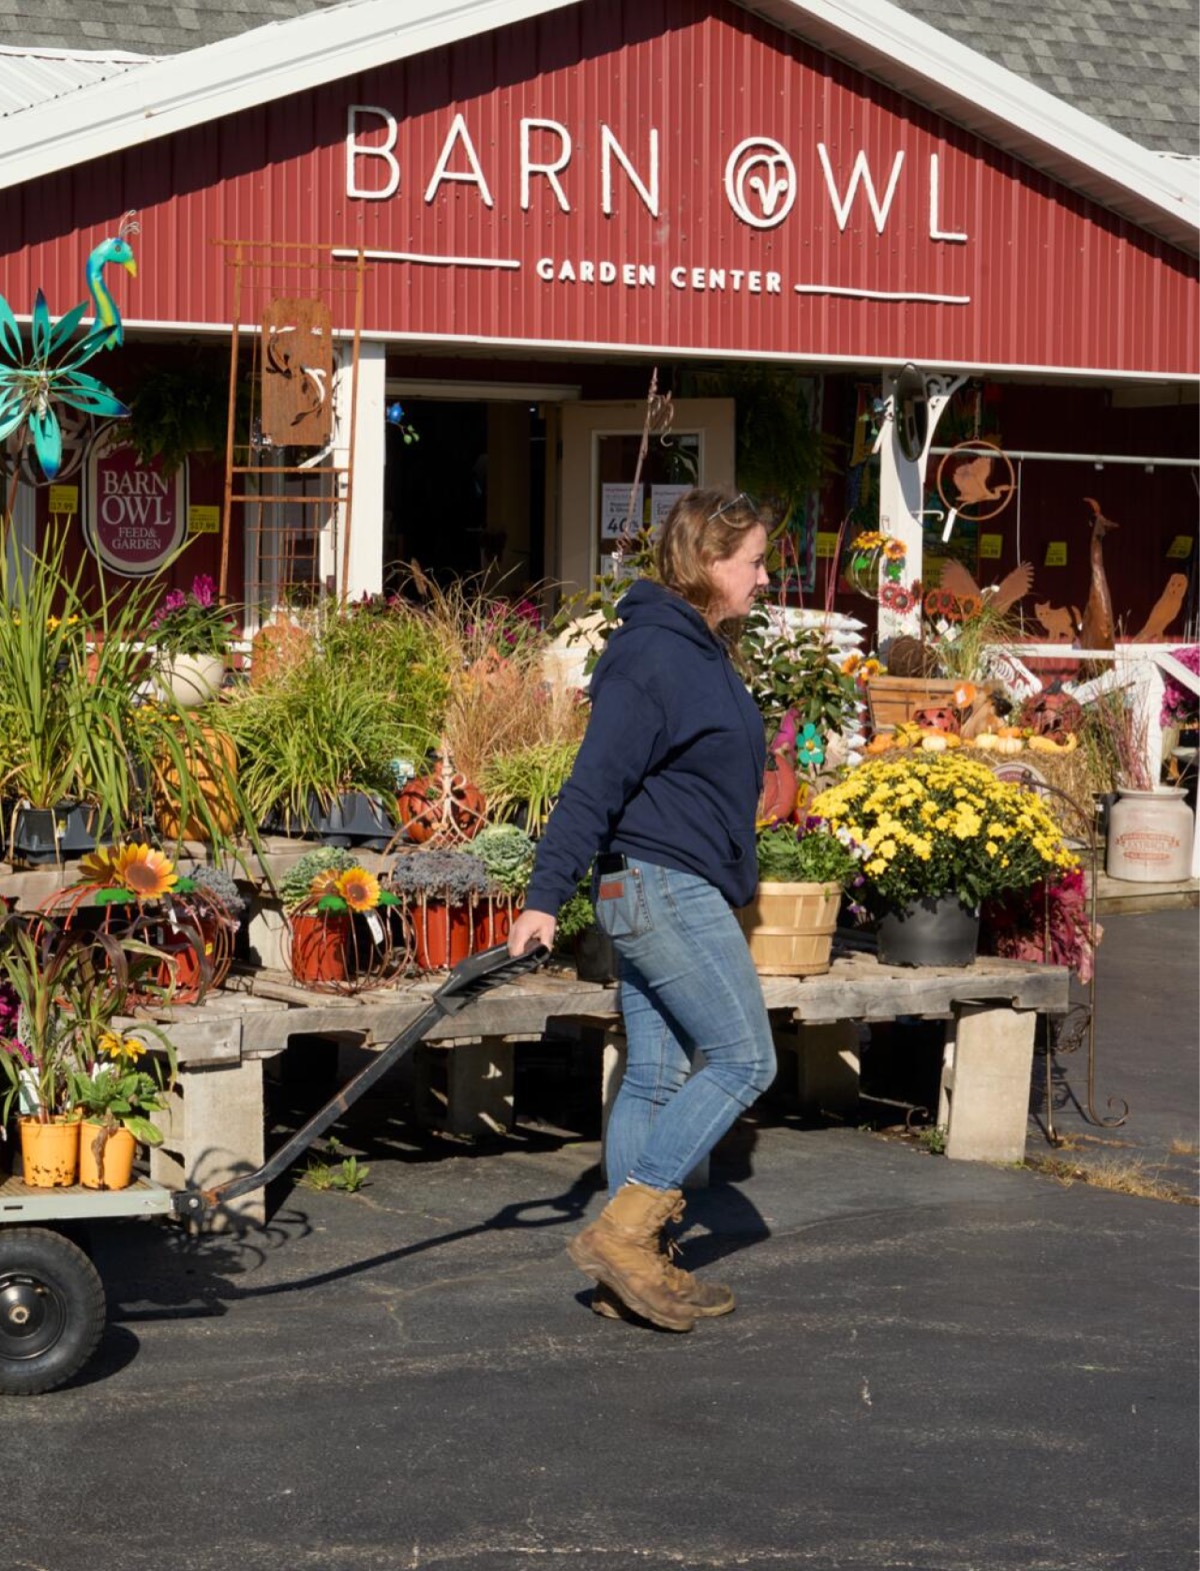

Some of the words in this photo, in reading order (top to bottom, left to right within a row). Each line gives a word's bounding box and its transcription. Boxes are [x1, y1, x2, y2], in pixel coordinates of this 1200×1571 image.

[345, 104, 660, 218] BARN
[724, 136, 969, 242] OWL
[536, 257, 657, 287] GARDEN
[670, 265, 782, 293] CENTER
[103, 470, 169, 495] BARN
[102, 494, 171, 525] OWL
[111, 538, 161, 550] GARDEN
